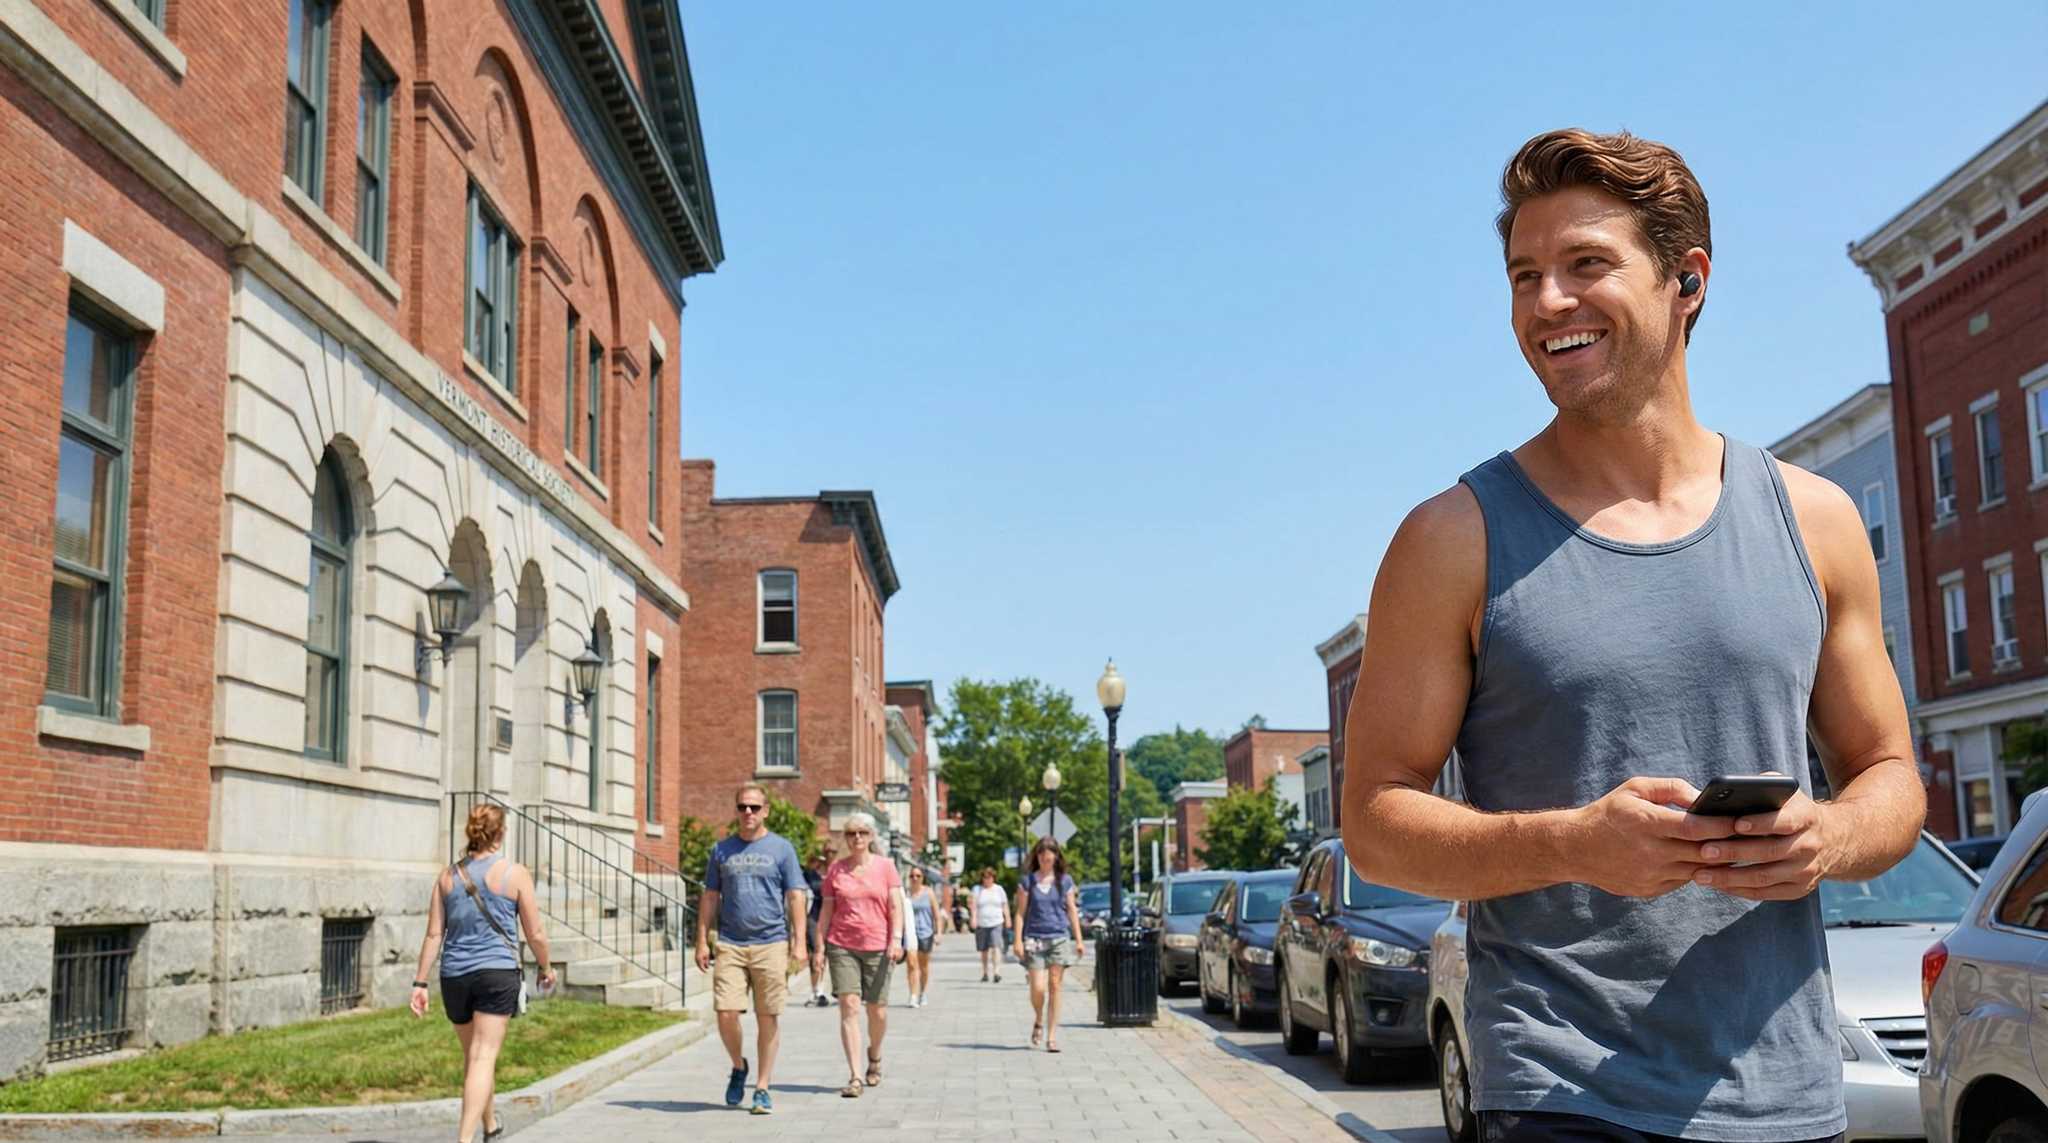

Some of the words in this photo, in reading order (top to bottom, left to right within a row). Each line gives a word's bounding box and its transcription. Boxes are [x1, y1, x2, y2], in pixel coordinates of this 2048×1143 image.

[437, 371, 487, 433] VERMONT
[490, 421, 541, 480] HISTORICAL
[543, 467, 575, 507] SOCIETY
